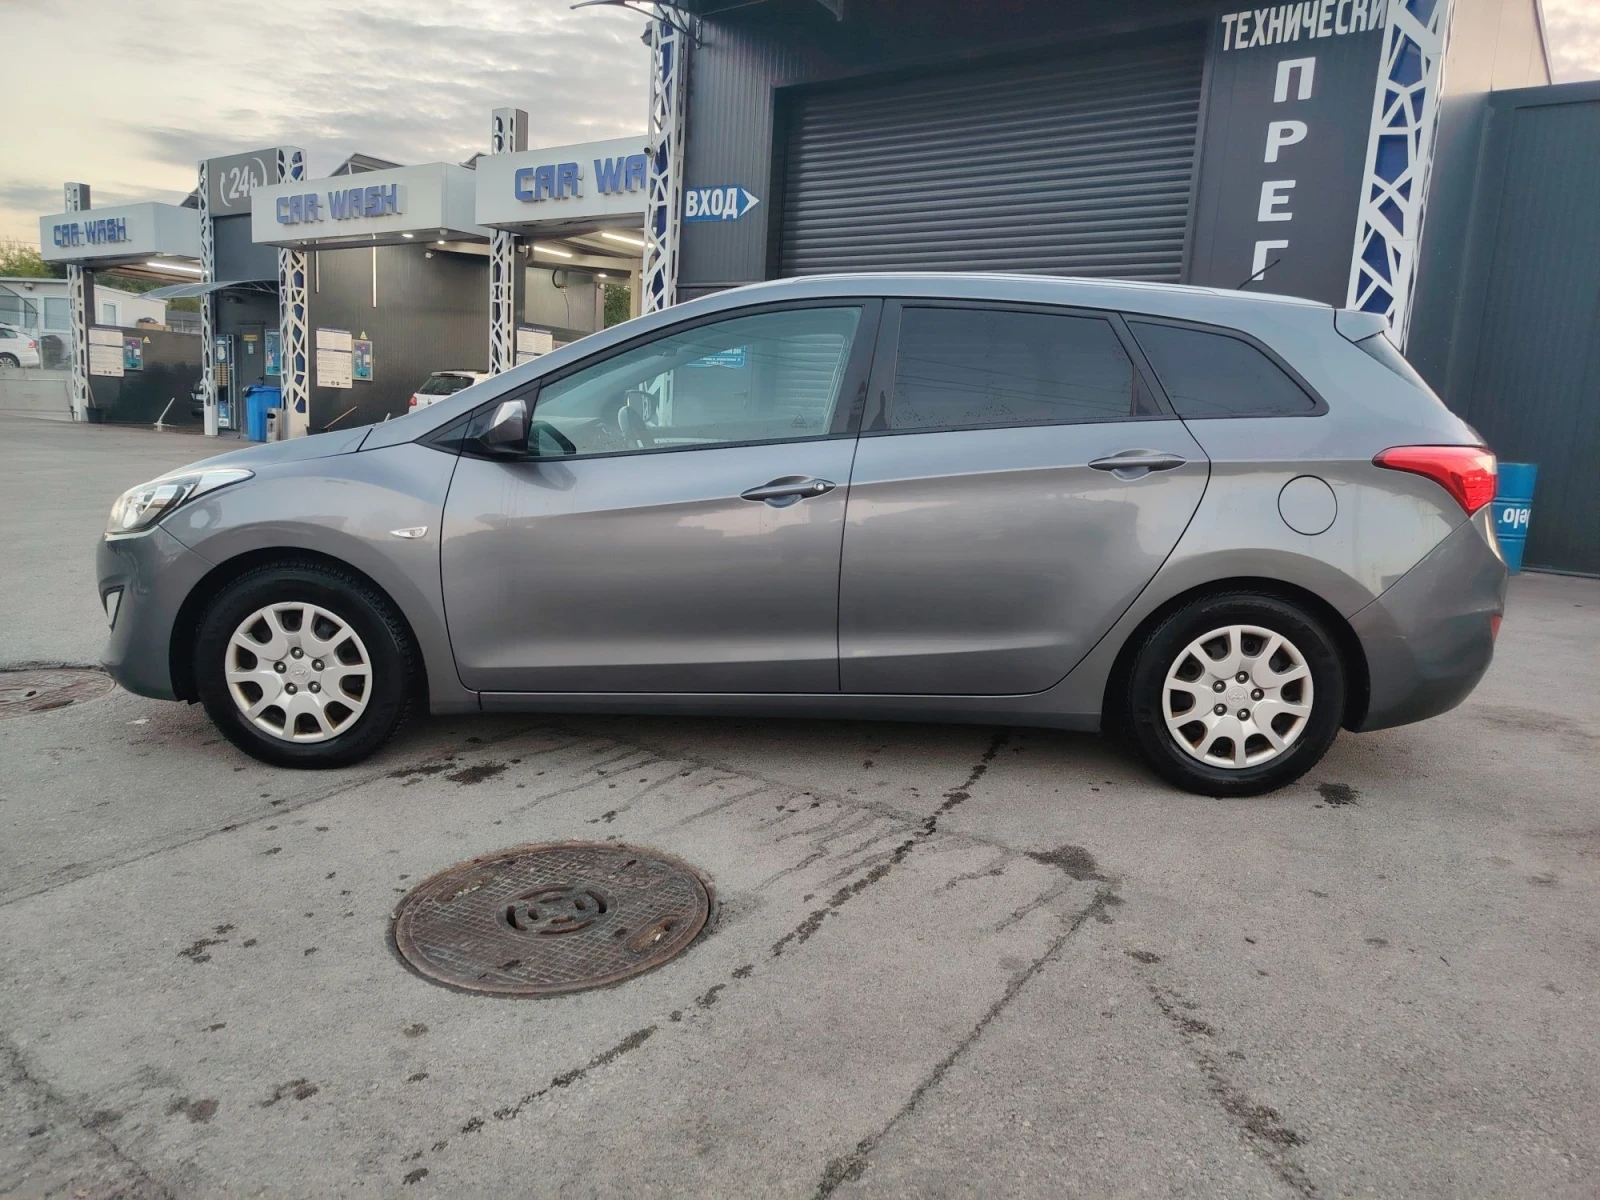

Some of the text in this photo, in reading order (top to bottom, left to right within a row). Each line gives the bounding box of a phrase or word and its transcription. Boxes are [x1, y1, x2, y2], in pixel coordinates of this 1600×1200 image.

[1221, 0, 1386, 51] ТЕХНИЧЕСКИ
[514, 162, 580, 202] CAR
[276, 185, 397, 224] CAR WASH
[685, 187, 738, 219] ВХОД
[53, 217, 127, 247] CAR WASH
